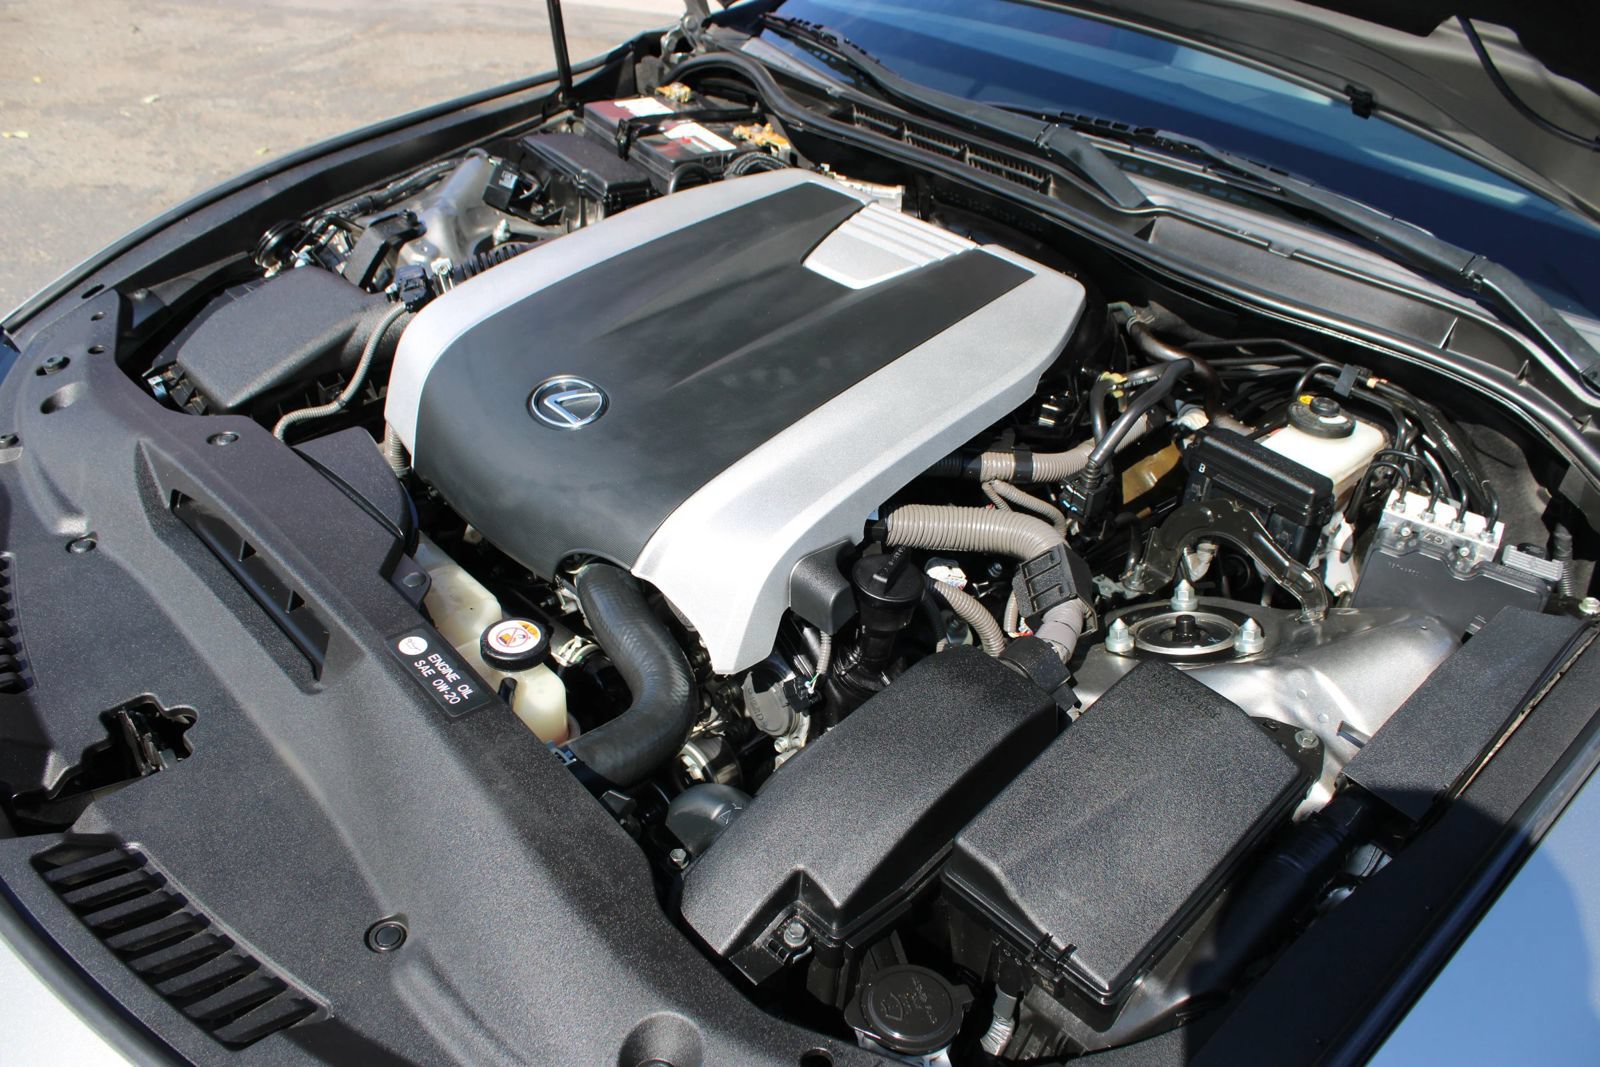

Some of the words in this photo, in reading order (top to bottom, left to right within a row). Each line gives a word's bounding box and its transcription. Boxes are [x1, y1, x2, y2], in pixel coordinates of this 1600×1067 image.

[414, 659, 436, 678] SAE
[432, 678, 461, 705] 0W-20
[427, 653, 461, 683] ENGINE
[457, 684, 475, 700] OIL
